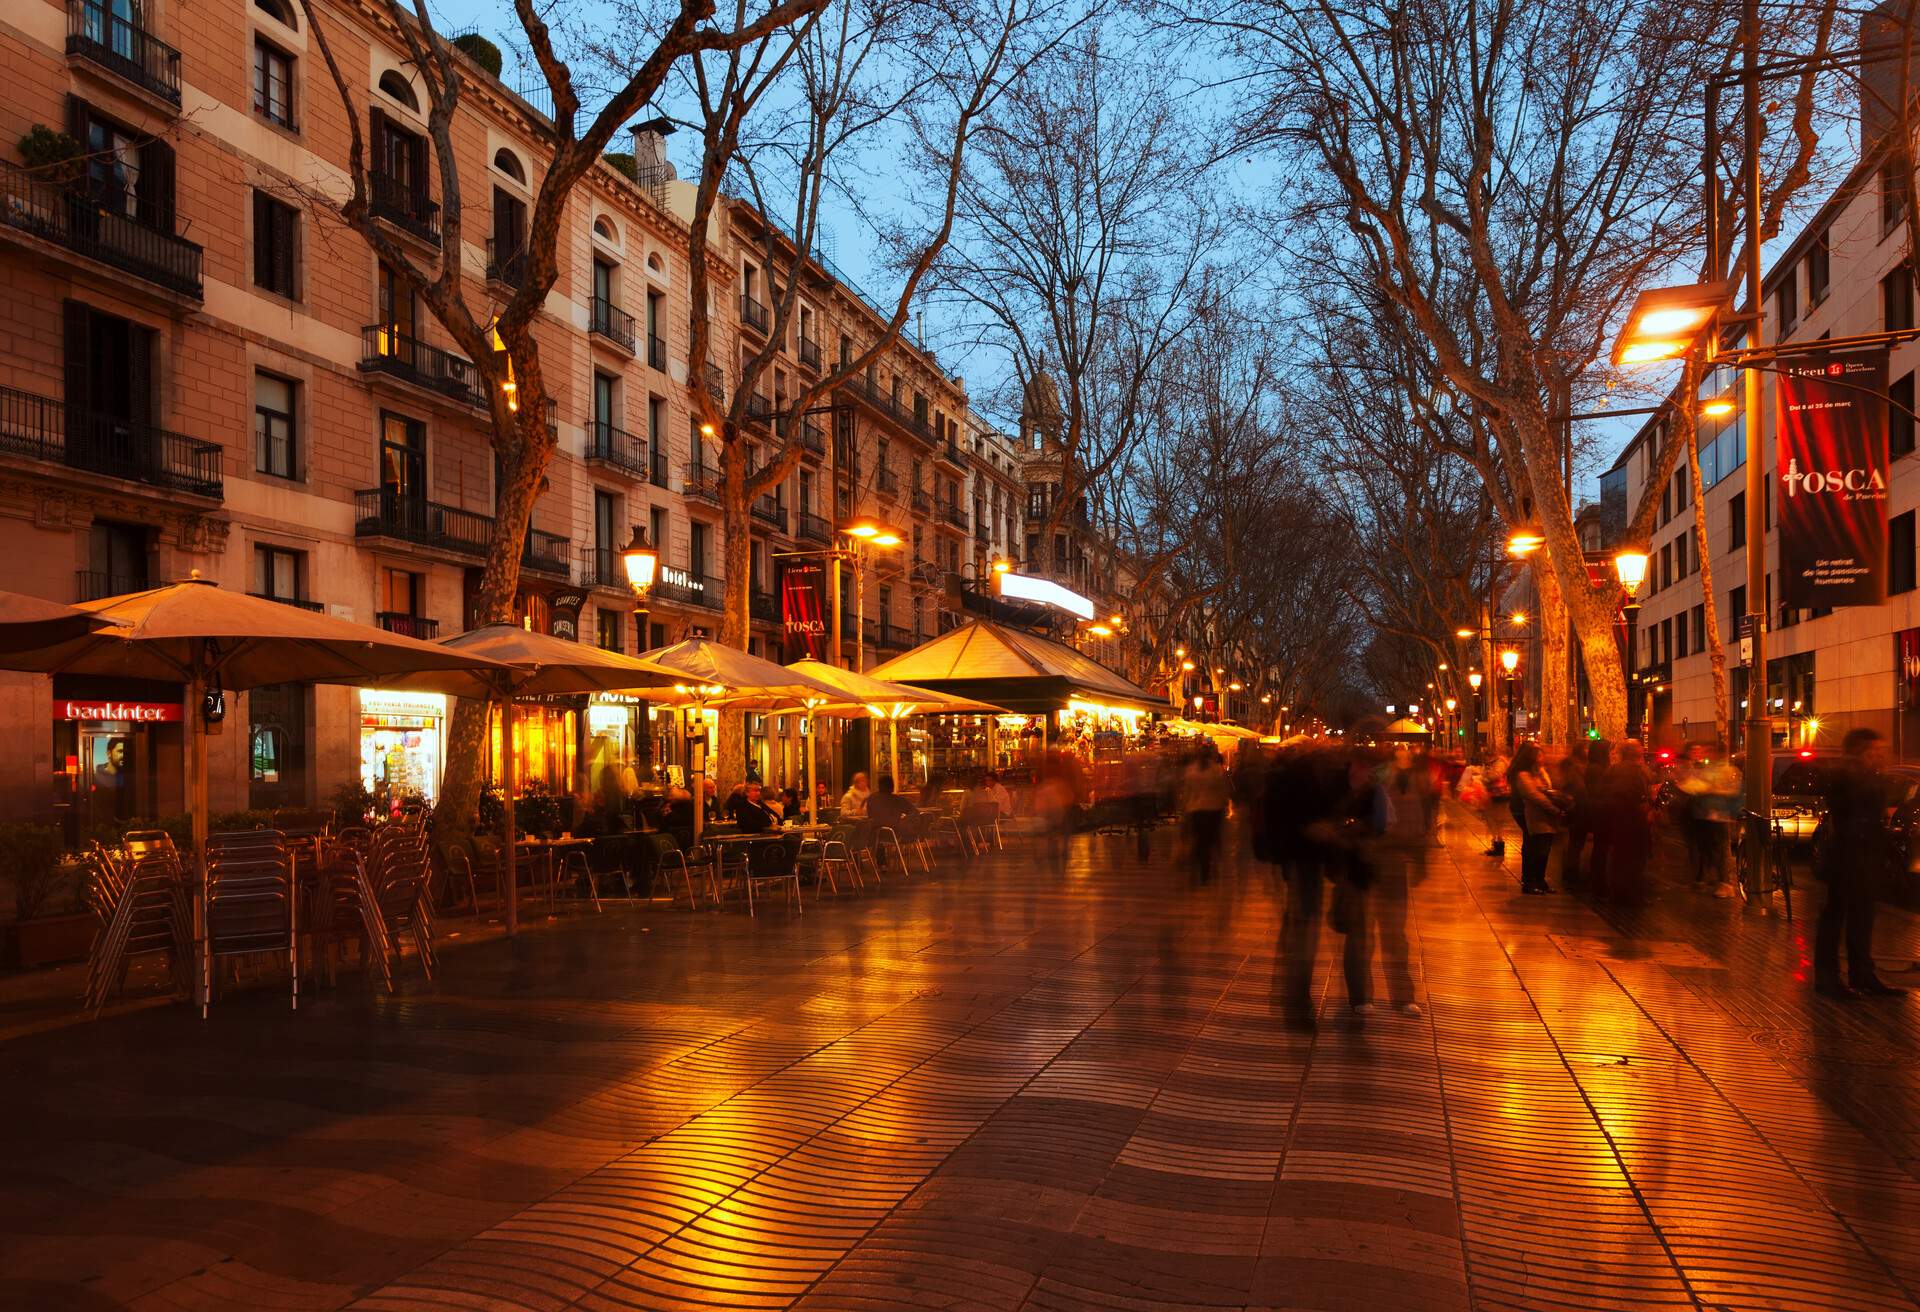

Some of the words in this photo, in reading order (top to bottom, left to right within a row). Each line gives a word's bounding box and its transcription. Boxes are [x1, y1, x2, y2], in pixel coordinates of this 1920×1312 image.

[1789, 367, 1825, 378] Liceu
[1843, 493, 1854, 501] de
[1815, 559, 1830, 567] Un
[662, 566, 687, 587] Hotel
[1802, 569, 1815, 577] de
